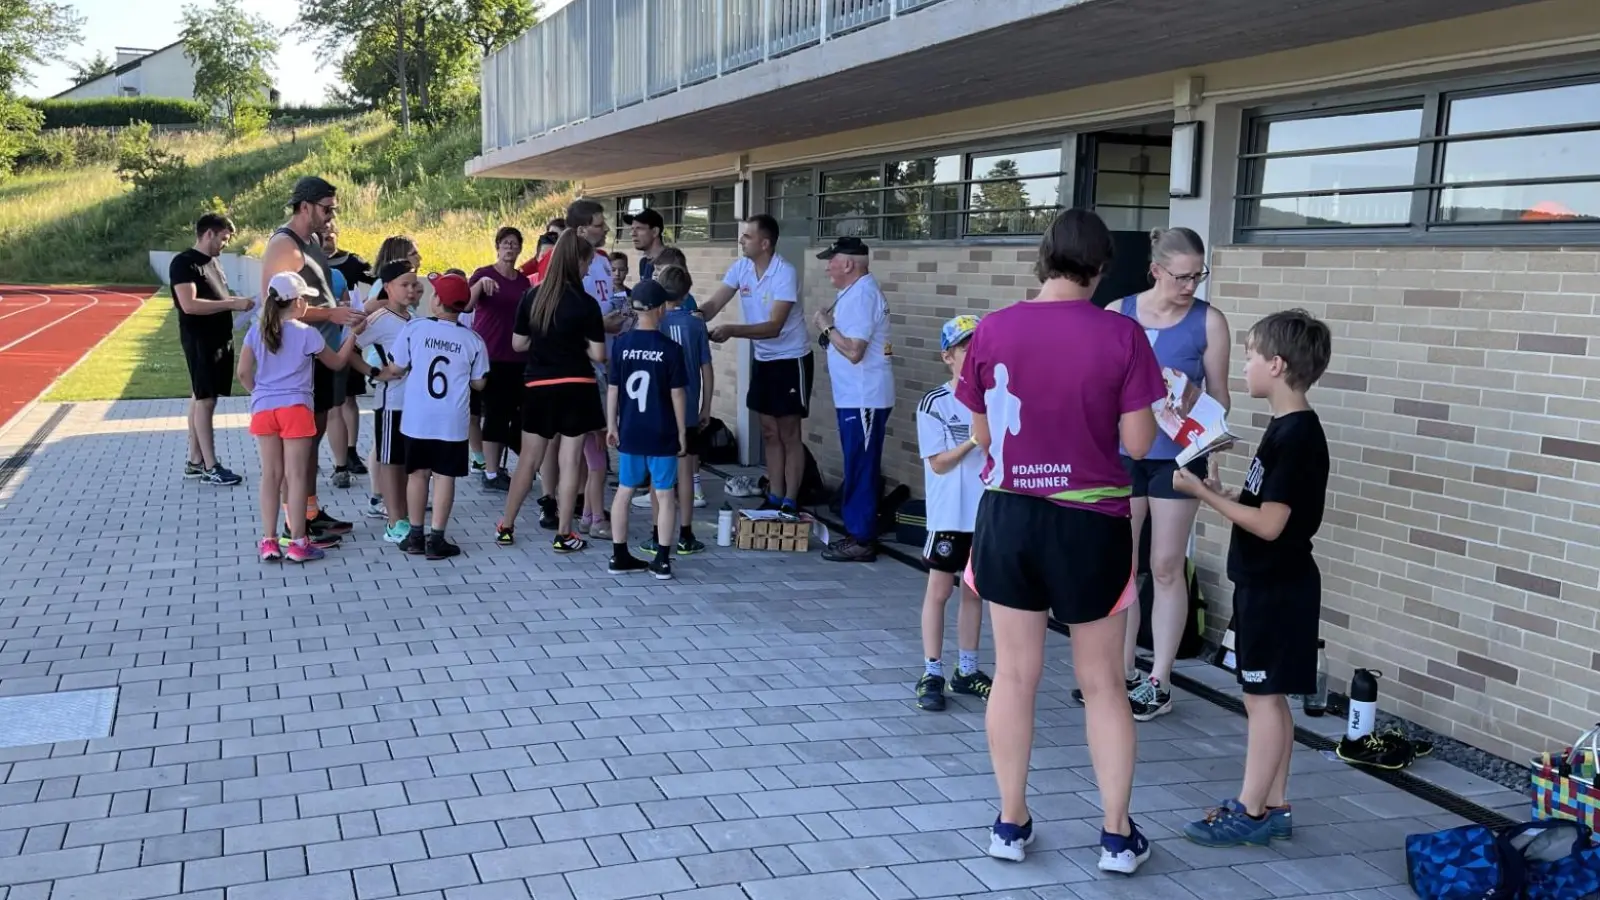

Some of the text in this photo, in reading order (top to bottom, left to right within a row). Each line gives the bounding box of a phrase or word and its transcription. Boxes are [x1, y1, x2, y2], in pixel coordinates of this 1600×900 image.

[424, 337, 462, 354] KIMMICH
[622, 349, 664, 362] PATRICK
[427, 355, 450, 400] 6
[625, 370, 651, 413] 9
[1011, 463, 1072, 475] #DAHOAM
[1012, 476, 1069, 489] #RUNNER
